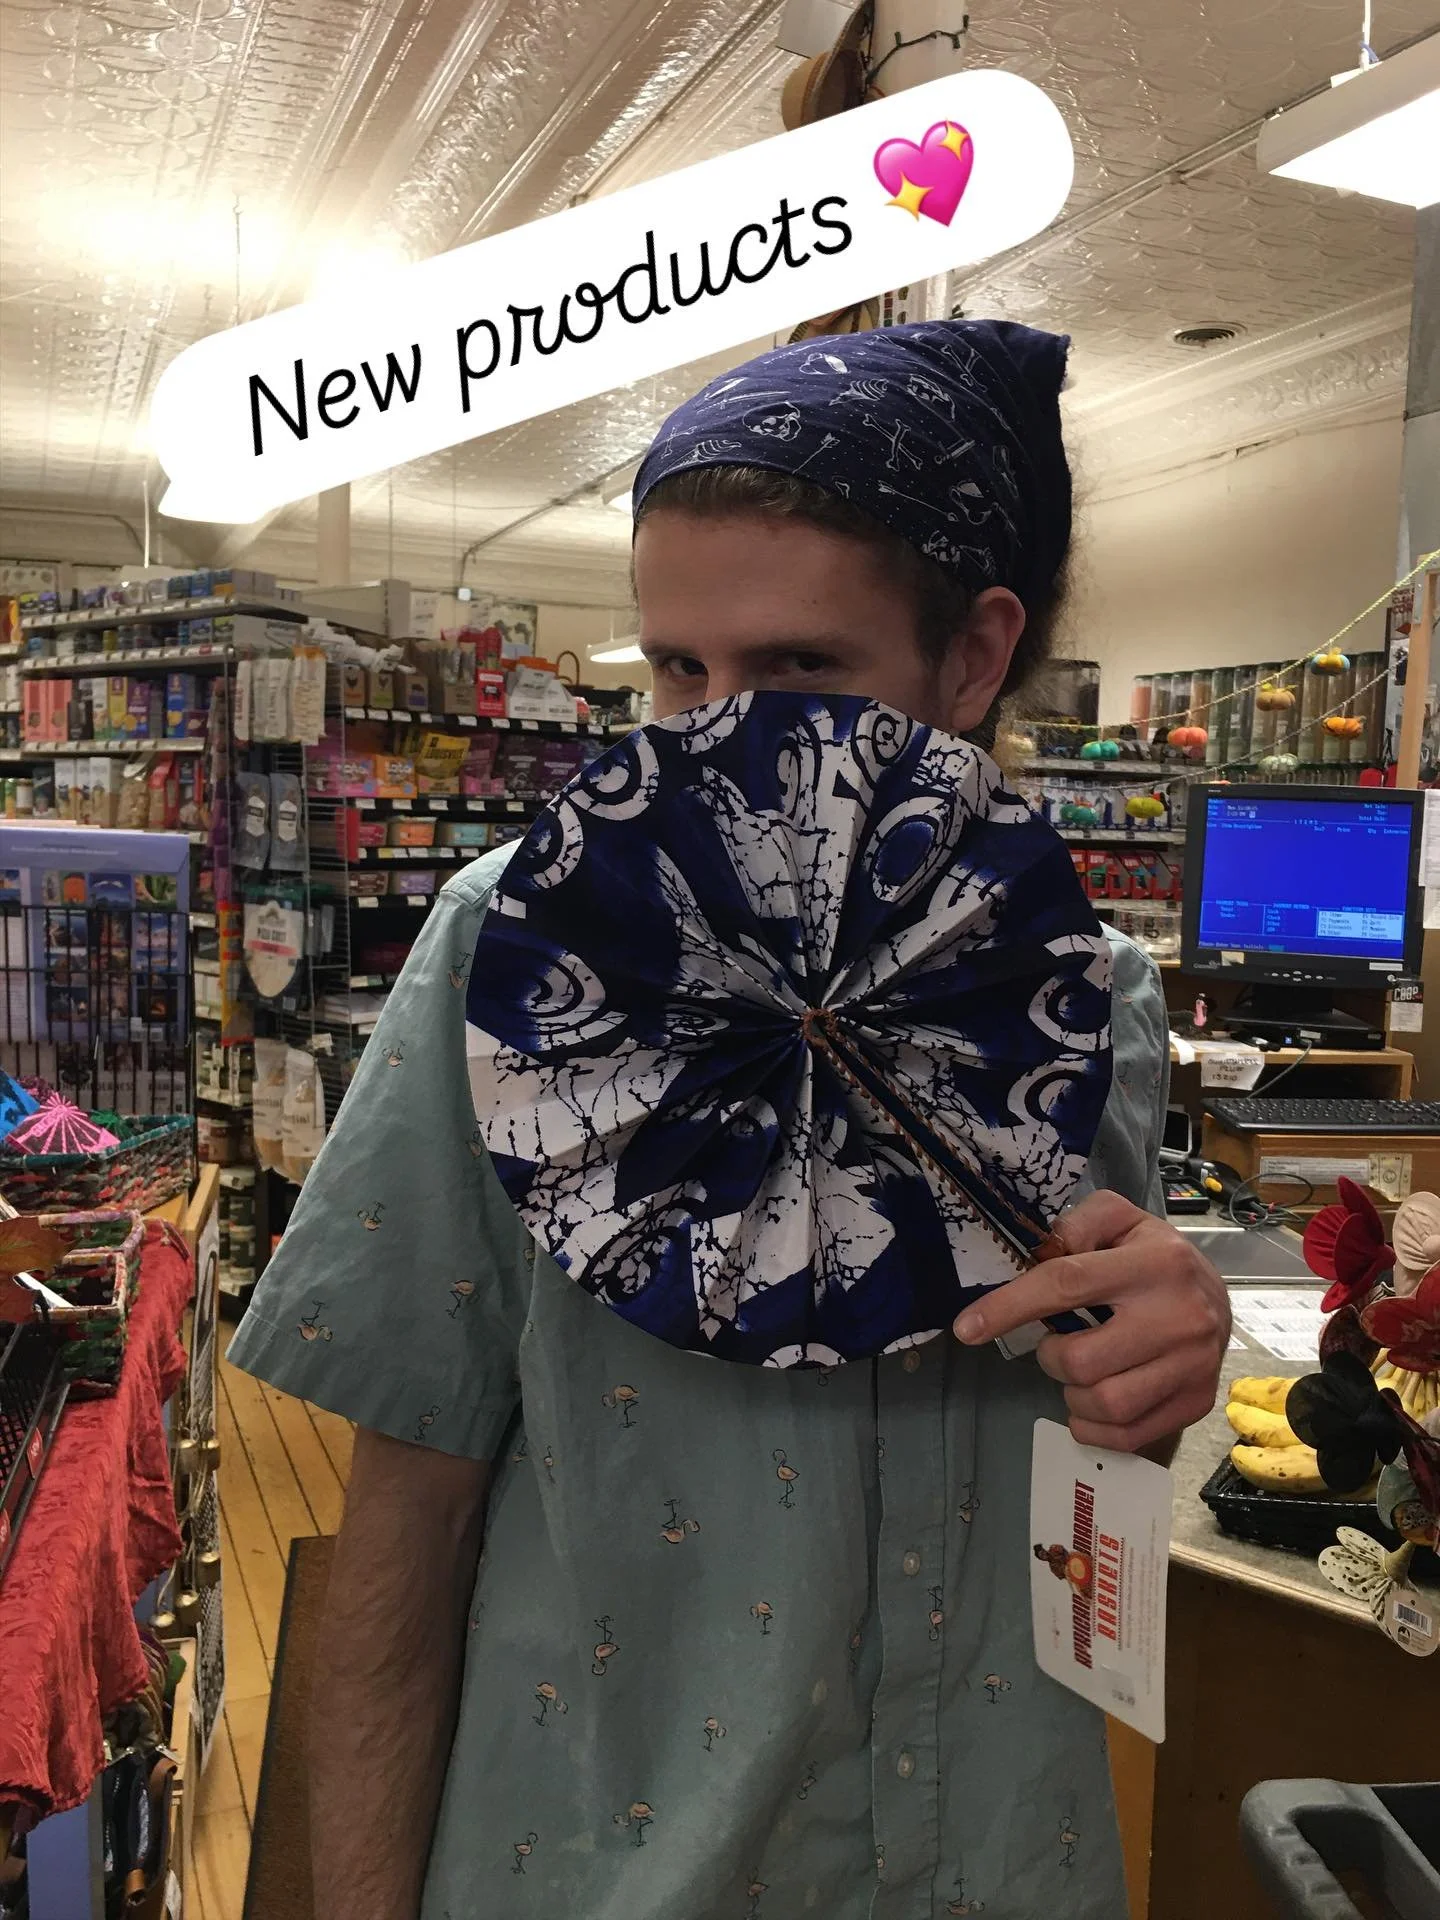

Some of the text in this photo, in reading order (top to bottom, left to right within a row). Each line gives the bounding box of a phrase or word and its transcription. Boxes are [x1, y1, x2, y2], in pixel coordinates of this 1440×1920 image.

[1071, 1478, 1096, 1670] AFRICAN MARKET
[1097, 1533, 1121, 1641] BASKETS
